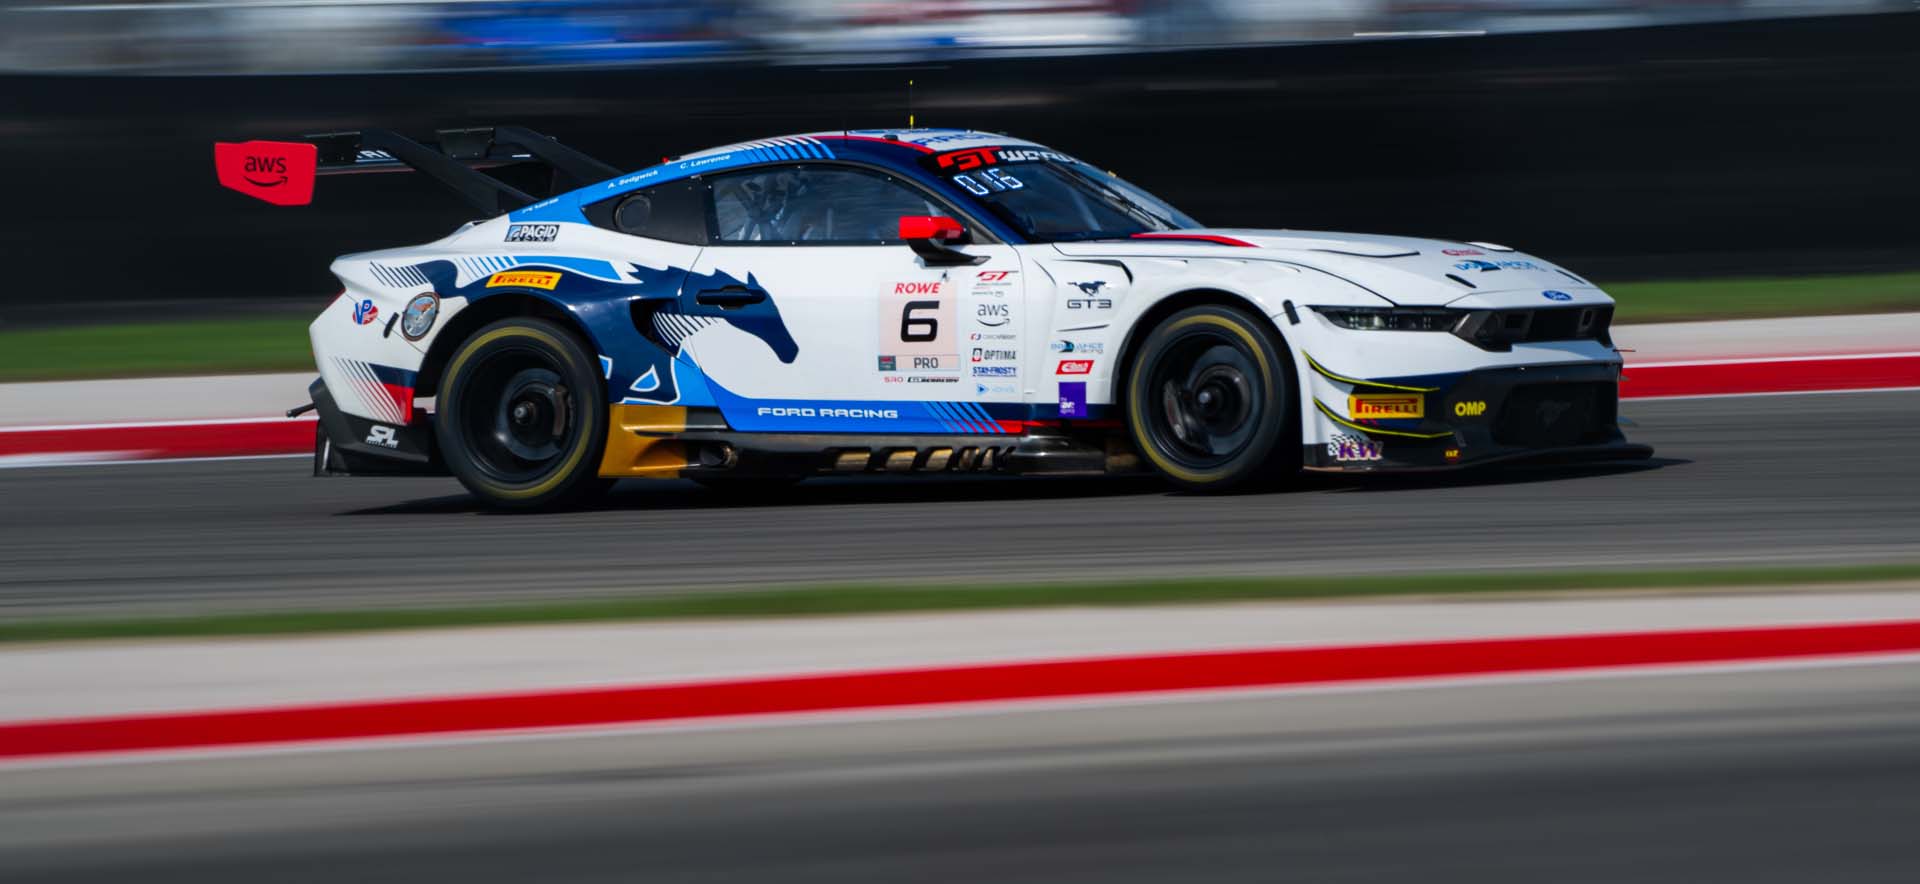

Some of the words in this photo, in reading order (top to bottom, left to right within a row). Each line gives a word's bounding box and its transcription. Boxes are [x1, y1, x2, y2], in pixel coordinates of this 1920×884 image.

[244, 155, 287, 174] aws
[691, 154, 731, 167] Lawrence
[937, 146, 1002, 170] GT
[519, 225, 557, 238] PAGID
[495, 275, 553, 286] PIRELLI
[895, 282, 940, 294] ROWE
[977, 303, 1009, 316] aws
[1067, 299, 1112, 309] GT3
[355, 299, 372, 325] VP
[901, 300, 940, 342] 6
[984, 350, 1016, 360] OPTIMA
[913, 357, 939, 369] PRO
[1355, 398, 1418, 414] PIRELLI
[1455, 402, 1486, 416] OMP
[757, 407, 816, 417] FORD
[819, 408, 898, 419] RACING
[1337, 441, 1382, 461] KW
